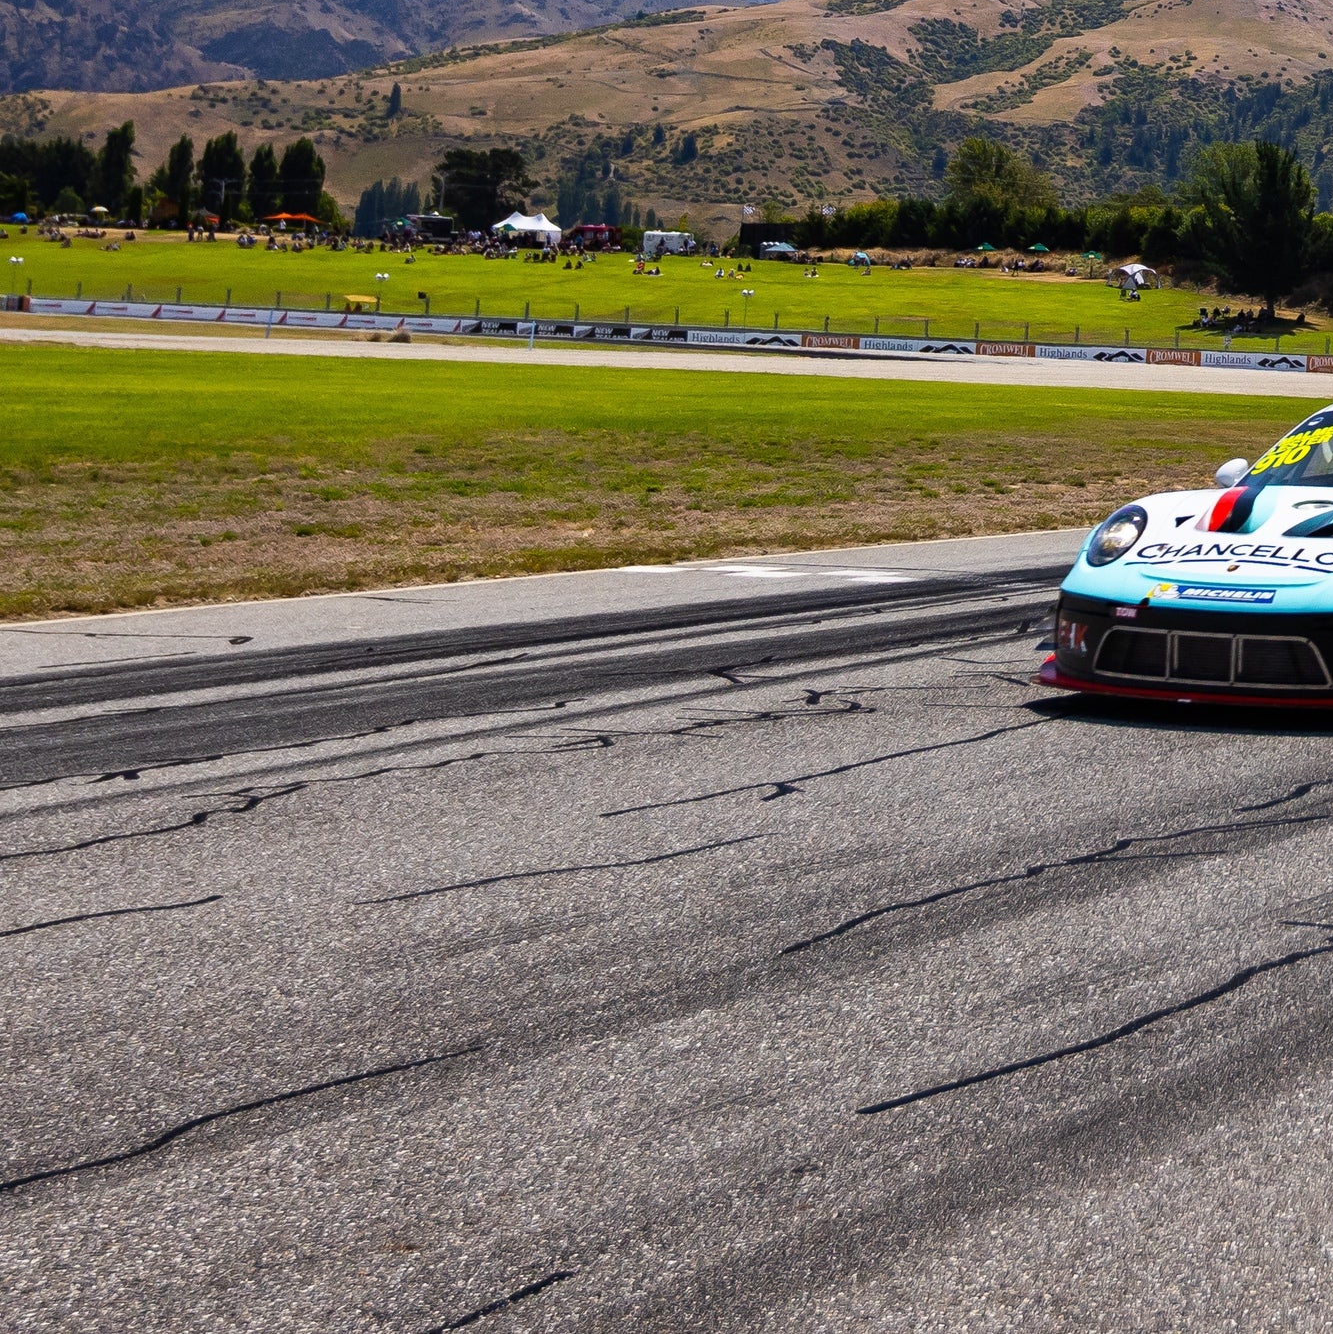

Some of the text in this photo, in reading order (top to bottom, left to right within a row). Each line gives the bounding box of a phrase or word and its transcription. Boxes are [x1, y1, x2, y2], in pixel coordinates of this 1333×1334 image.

[481, 320, 501, 329] NEW
[537, 323, 556, 332] NEW
[651, 329, 670, 337] NEW
[691, 332, 741, 344] Highlands
[805, 336, 854, 348] CROMWELL
[863, 340, 913, 351] Highlands
[980, 344, 1029, 357] CROMWELL
[1039, 347, 1088, 358] Highlands
[1149, 350, 1197, 366] CROMWELL
[1204, 353, 1252, 366] Highlands
[1250, 445, 1311, 475] 910
[1181, 588, 1275, 599] MICHELIN
